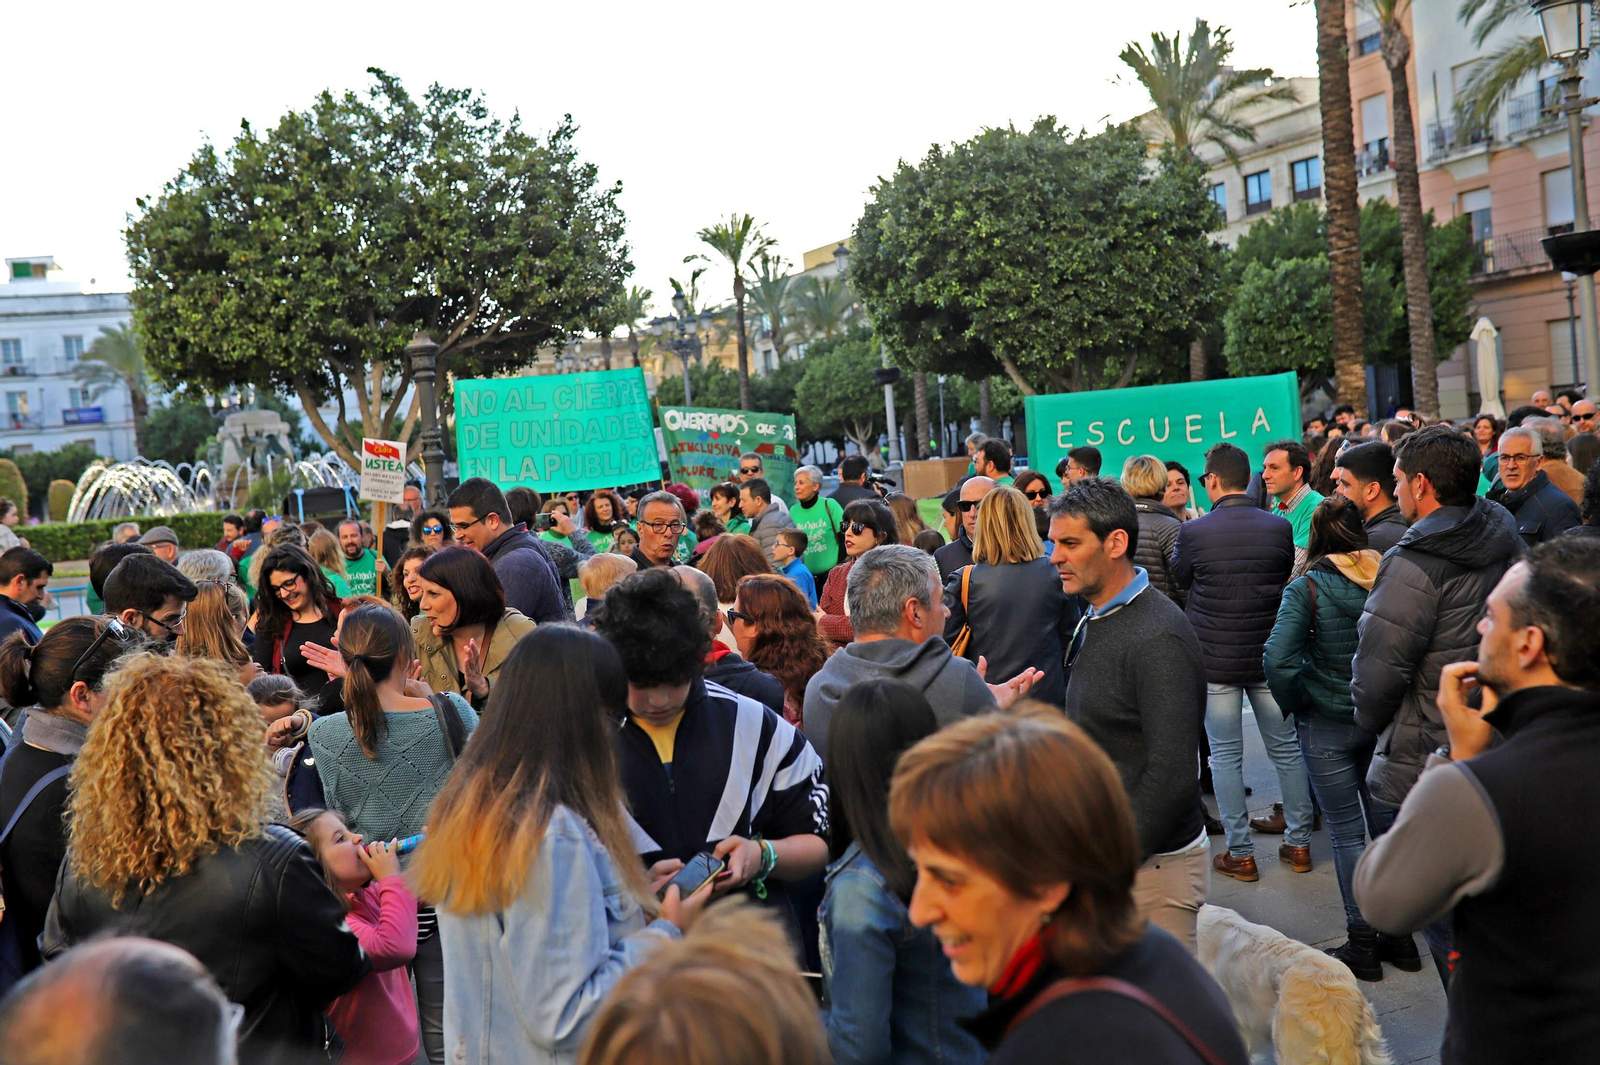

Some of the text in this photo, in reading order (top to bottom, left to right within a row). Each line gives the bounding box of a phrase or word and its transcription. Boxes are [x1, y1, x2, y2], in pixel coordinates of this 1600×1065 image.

[461, 377, 645, 418] NO AL CIERRE
[464, 410, 651, 450] DE UNIDADES
[663, 409, 749, 436] QUEREMOS
[755, 422, 777, 437] QUE
[1056, 407, 1271, 448] ESCUELA
[365, 458, 404, 472] USTEA
[466, 443, 660, 483] EN LA PÚBLICA
[678, 441, 742, 458] INCLUSIVA
